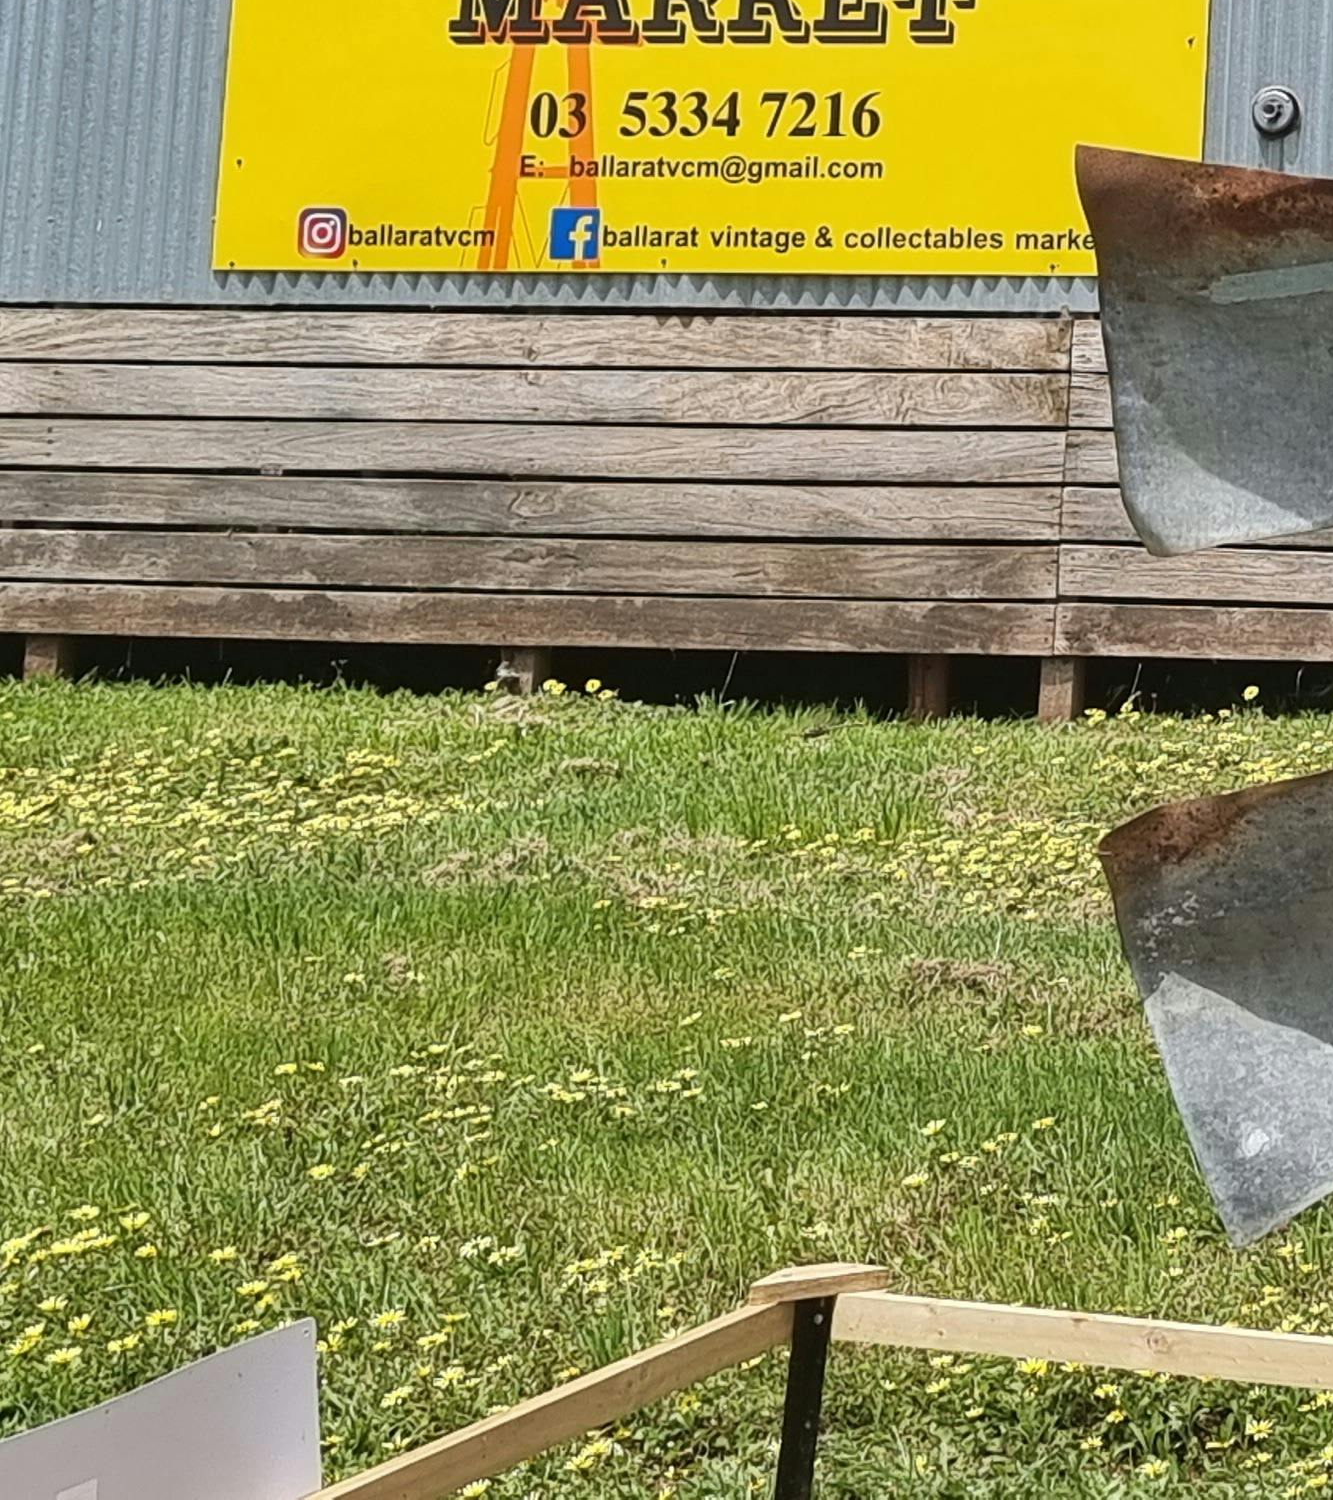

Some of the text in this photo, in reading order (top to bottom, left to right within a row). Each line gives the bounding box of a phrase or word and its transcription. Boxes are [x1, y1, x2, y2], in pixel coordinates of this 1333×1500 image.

[531, 92, 880, 137] 03 5334 7216
[520, 155, 882, 183] E: ballaratvcm@gmail.com
[350, 224, 494, 246] ballaratvcm
[603, 226, 698, 247] ballarat
[711, 228, 805, 253] vintage
[815, 226, 832, 247] &
[845, 227, 1002, 249] collectables
[1014, 228, 1097, 251] marke
